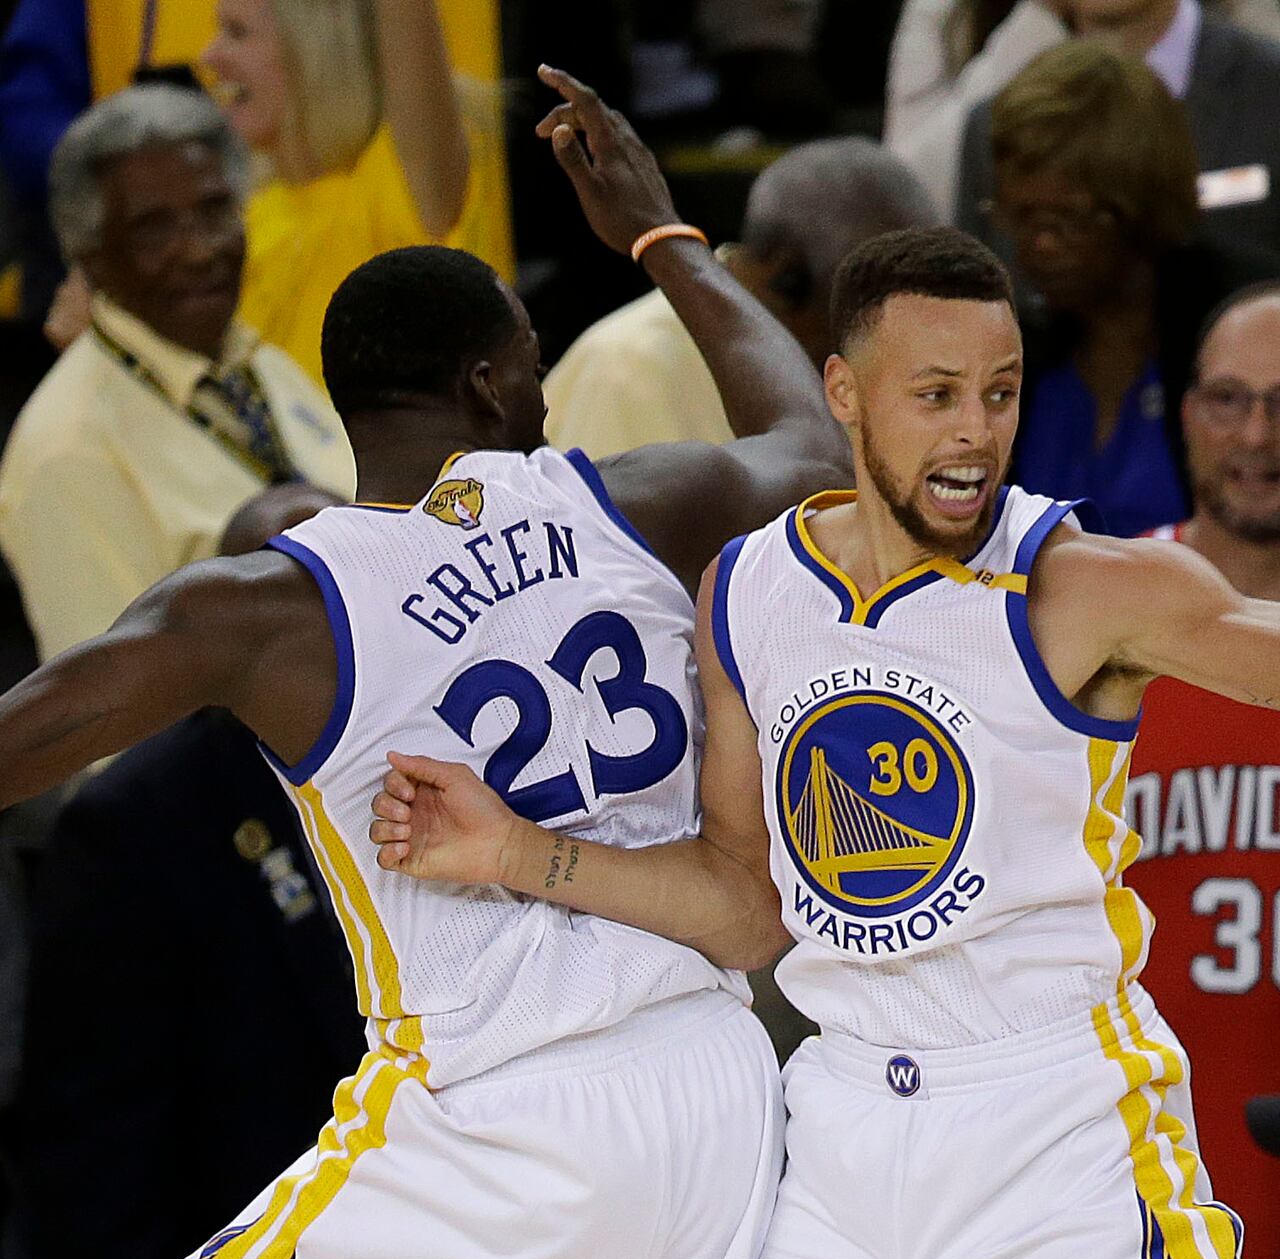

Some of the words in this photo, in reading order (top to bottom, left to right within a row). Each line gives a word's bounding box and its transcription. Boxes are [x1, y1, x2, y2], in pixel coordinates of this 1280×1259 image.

[438, 480, 481, 512] Finals
[402, 521, 580, 645] GREEN
[433, 610, 688, 824] 23
[770, 667, 871, 745] GOLDEN
[884, 670, 971, 735] STATE
[865, 740, 939, 797] 30
[792, 866, 986, 956] WARRIORS
[889, 1065, 916, 1087] W
